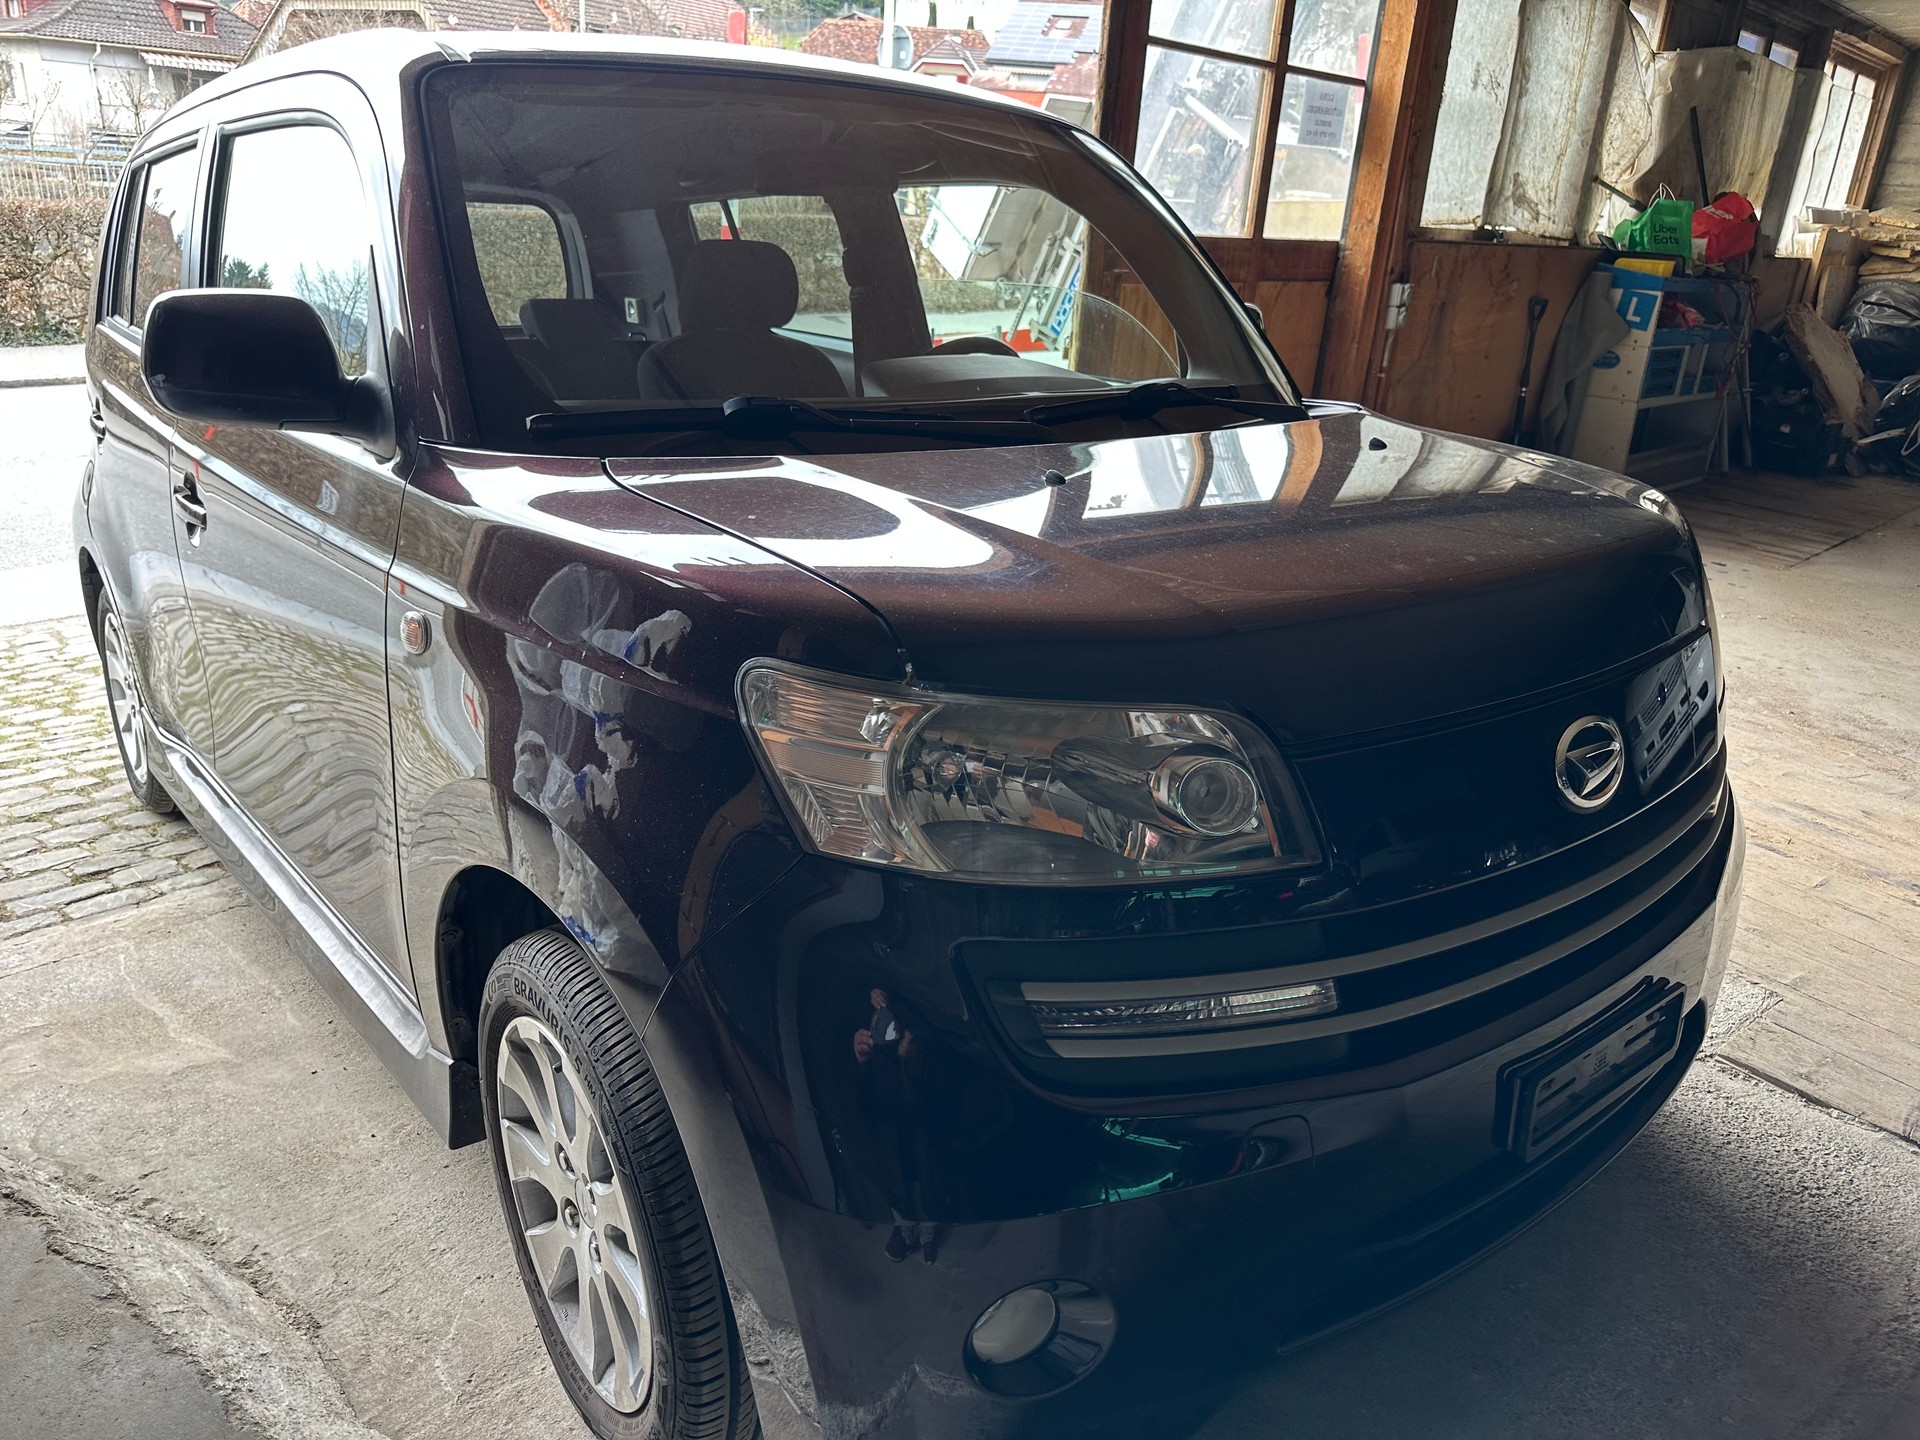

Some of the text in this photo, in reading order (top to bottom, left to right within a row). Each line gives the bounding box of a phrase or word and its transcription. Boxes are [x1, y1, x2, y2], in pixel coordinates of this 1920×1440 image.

[1653, 224, 1678, 234] Uber
[1653, 235, 1680, 245] Eats
[1626, 296, 1641, 323] L
[514, 977, 597, 1100] BRAVURIS 5 HM
